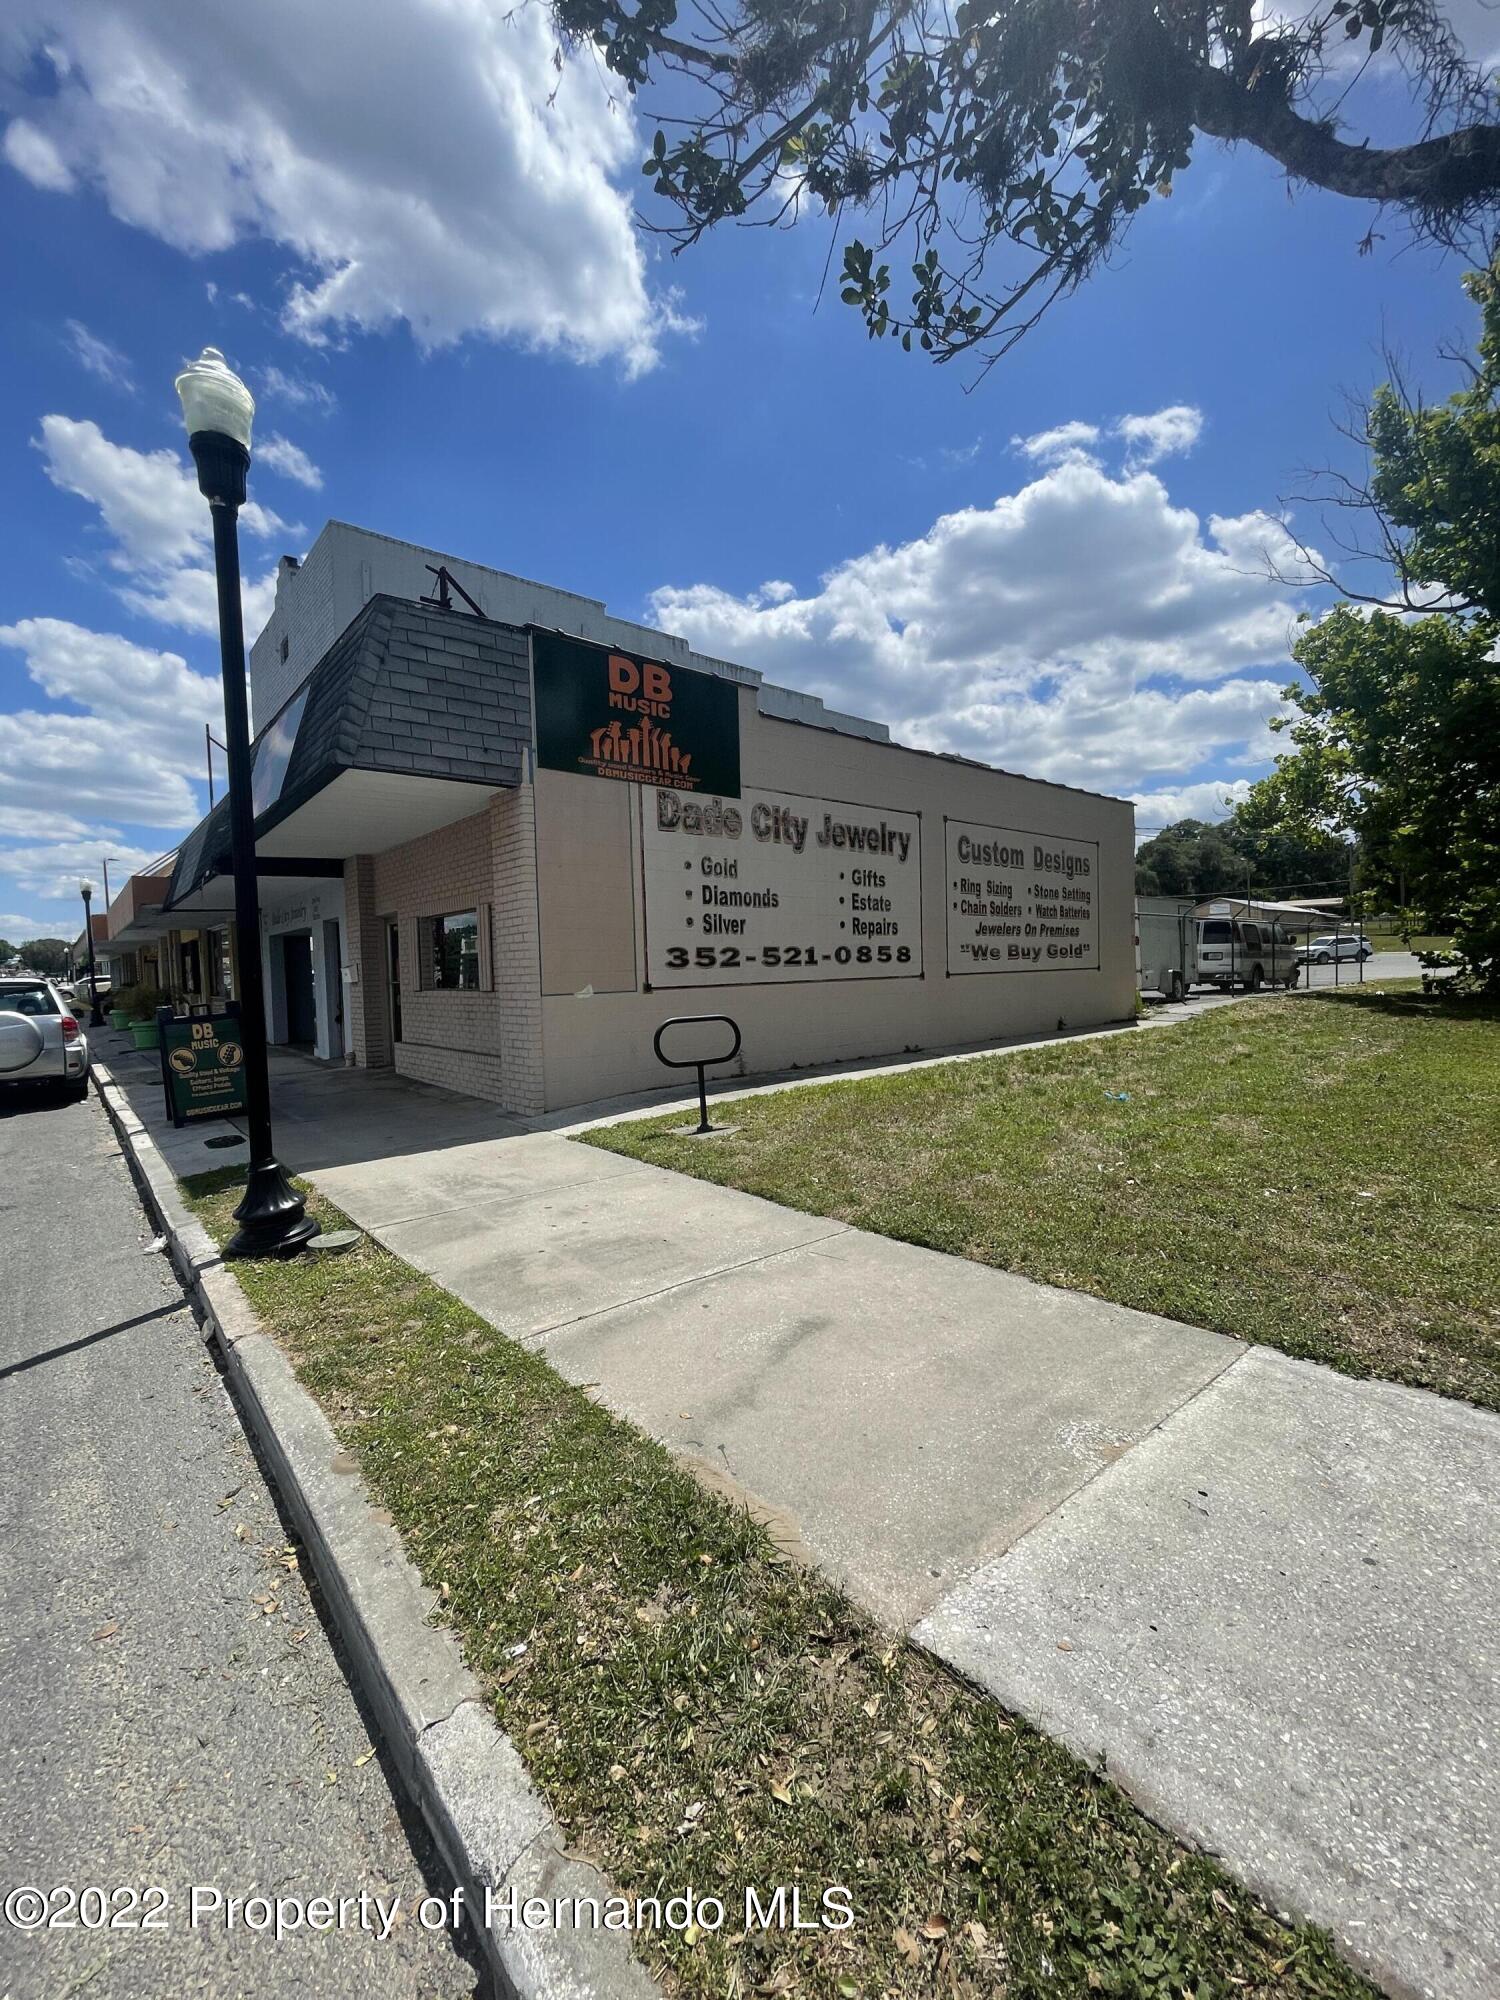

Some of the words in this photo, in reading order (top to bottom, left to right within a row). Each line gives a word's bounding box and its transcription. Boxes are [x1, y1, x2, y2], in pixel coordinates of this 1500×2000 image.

[608, 654, 673, 703] DB
[608, 692, 671, 719] MUSIC
[597, 767, 694, 790] DBMUSICGEAR.COM
[656, 788, 743, 840] Dade
[750, 802, 810, 855] City
[816, 813, 912, 865] Jewelry
[701, 856, 738, 880] Gold
[958, 835, 1025, 869] Custom
[1033, 845, 1090, 880] Designs
[851, 868, 886, 889] Gifts
[960, 878, 981, 899] Ring
[986, 880, 1013, 899] Sizing
[701, 884, 780, 909] Diamonds
[851, 892, 892, 912] Estate
[1034, 884, 1059, 899] Stone
[1062, 886, 1091, 906] Setting
[960, 899, 987, 916] Chain
[989, 901, 1022, 917] Solders
[1036, 903, 1058, 919] Watch
[1059, 905, 1090, 920] Batteries
[702, 913, 747, 936] Silver
[852, 917, 899, 940] Repairs
[975, 921, 1021, 937] Jewelers
[1024, 923, 1037, 937] On
[1039, 923, 1080, 937] Premises
[665, 945, 911, 969] 352-521-0858
[1007, 944, 1041, 963] Buy
[191, 1022, 214, 1040] DB
[191, 1038, 220, 1051] MUSIC
